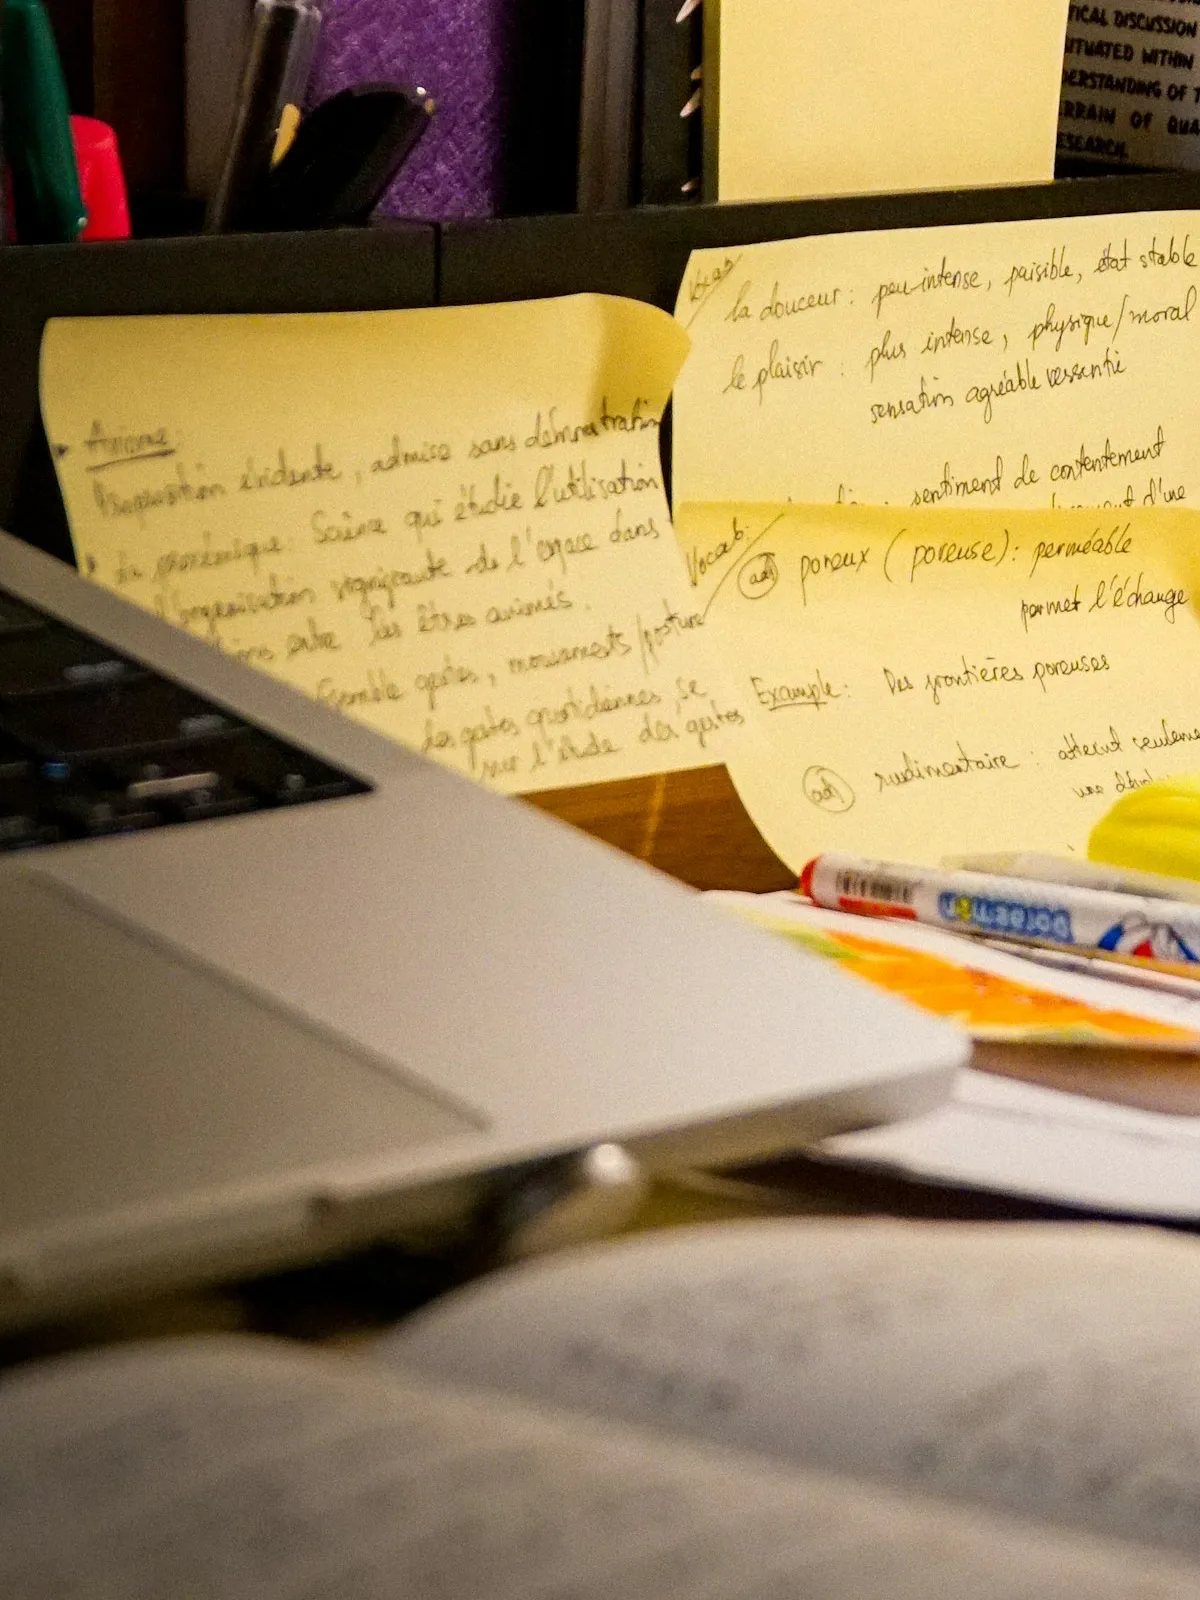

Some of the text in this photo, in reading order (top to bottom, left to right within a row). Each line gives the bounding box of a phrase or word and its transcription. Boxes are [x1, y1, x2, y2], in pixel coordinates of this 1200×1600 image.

[1113, 9, 1197, 38] DISCUSSION
[1142, 47, 1194, 70] WITHIN
[1166, 83, 1188, 100] OF
[1129, 111, 1153, 129] OF
[1139, 234, 1198, 270] stable
[751, 339, 824, 407] plaisir
[865, 330, 907, 384] plus
[870, 376, 955, 424] sensation
[965, 358, 1041, 424] agréable
[467, 434, 517, 458] sans
[910, 455, 1004, 508] sentiment
[1013, 453, 1041, 490] de
[1050, 424, 1166, 483] contentement
[1143, 476, 1187, 507] d'une
[608, 507, 662, 544] dans
[1029, 522, 1133, 579] perméable
[1020, 571, 1189, 634] permet l'échange
[924, 654, 1023, 705] frontières
[1031, 653, 1111, 694] poreuses
[873, 740, 1021, 793] rudimentaire
